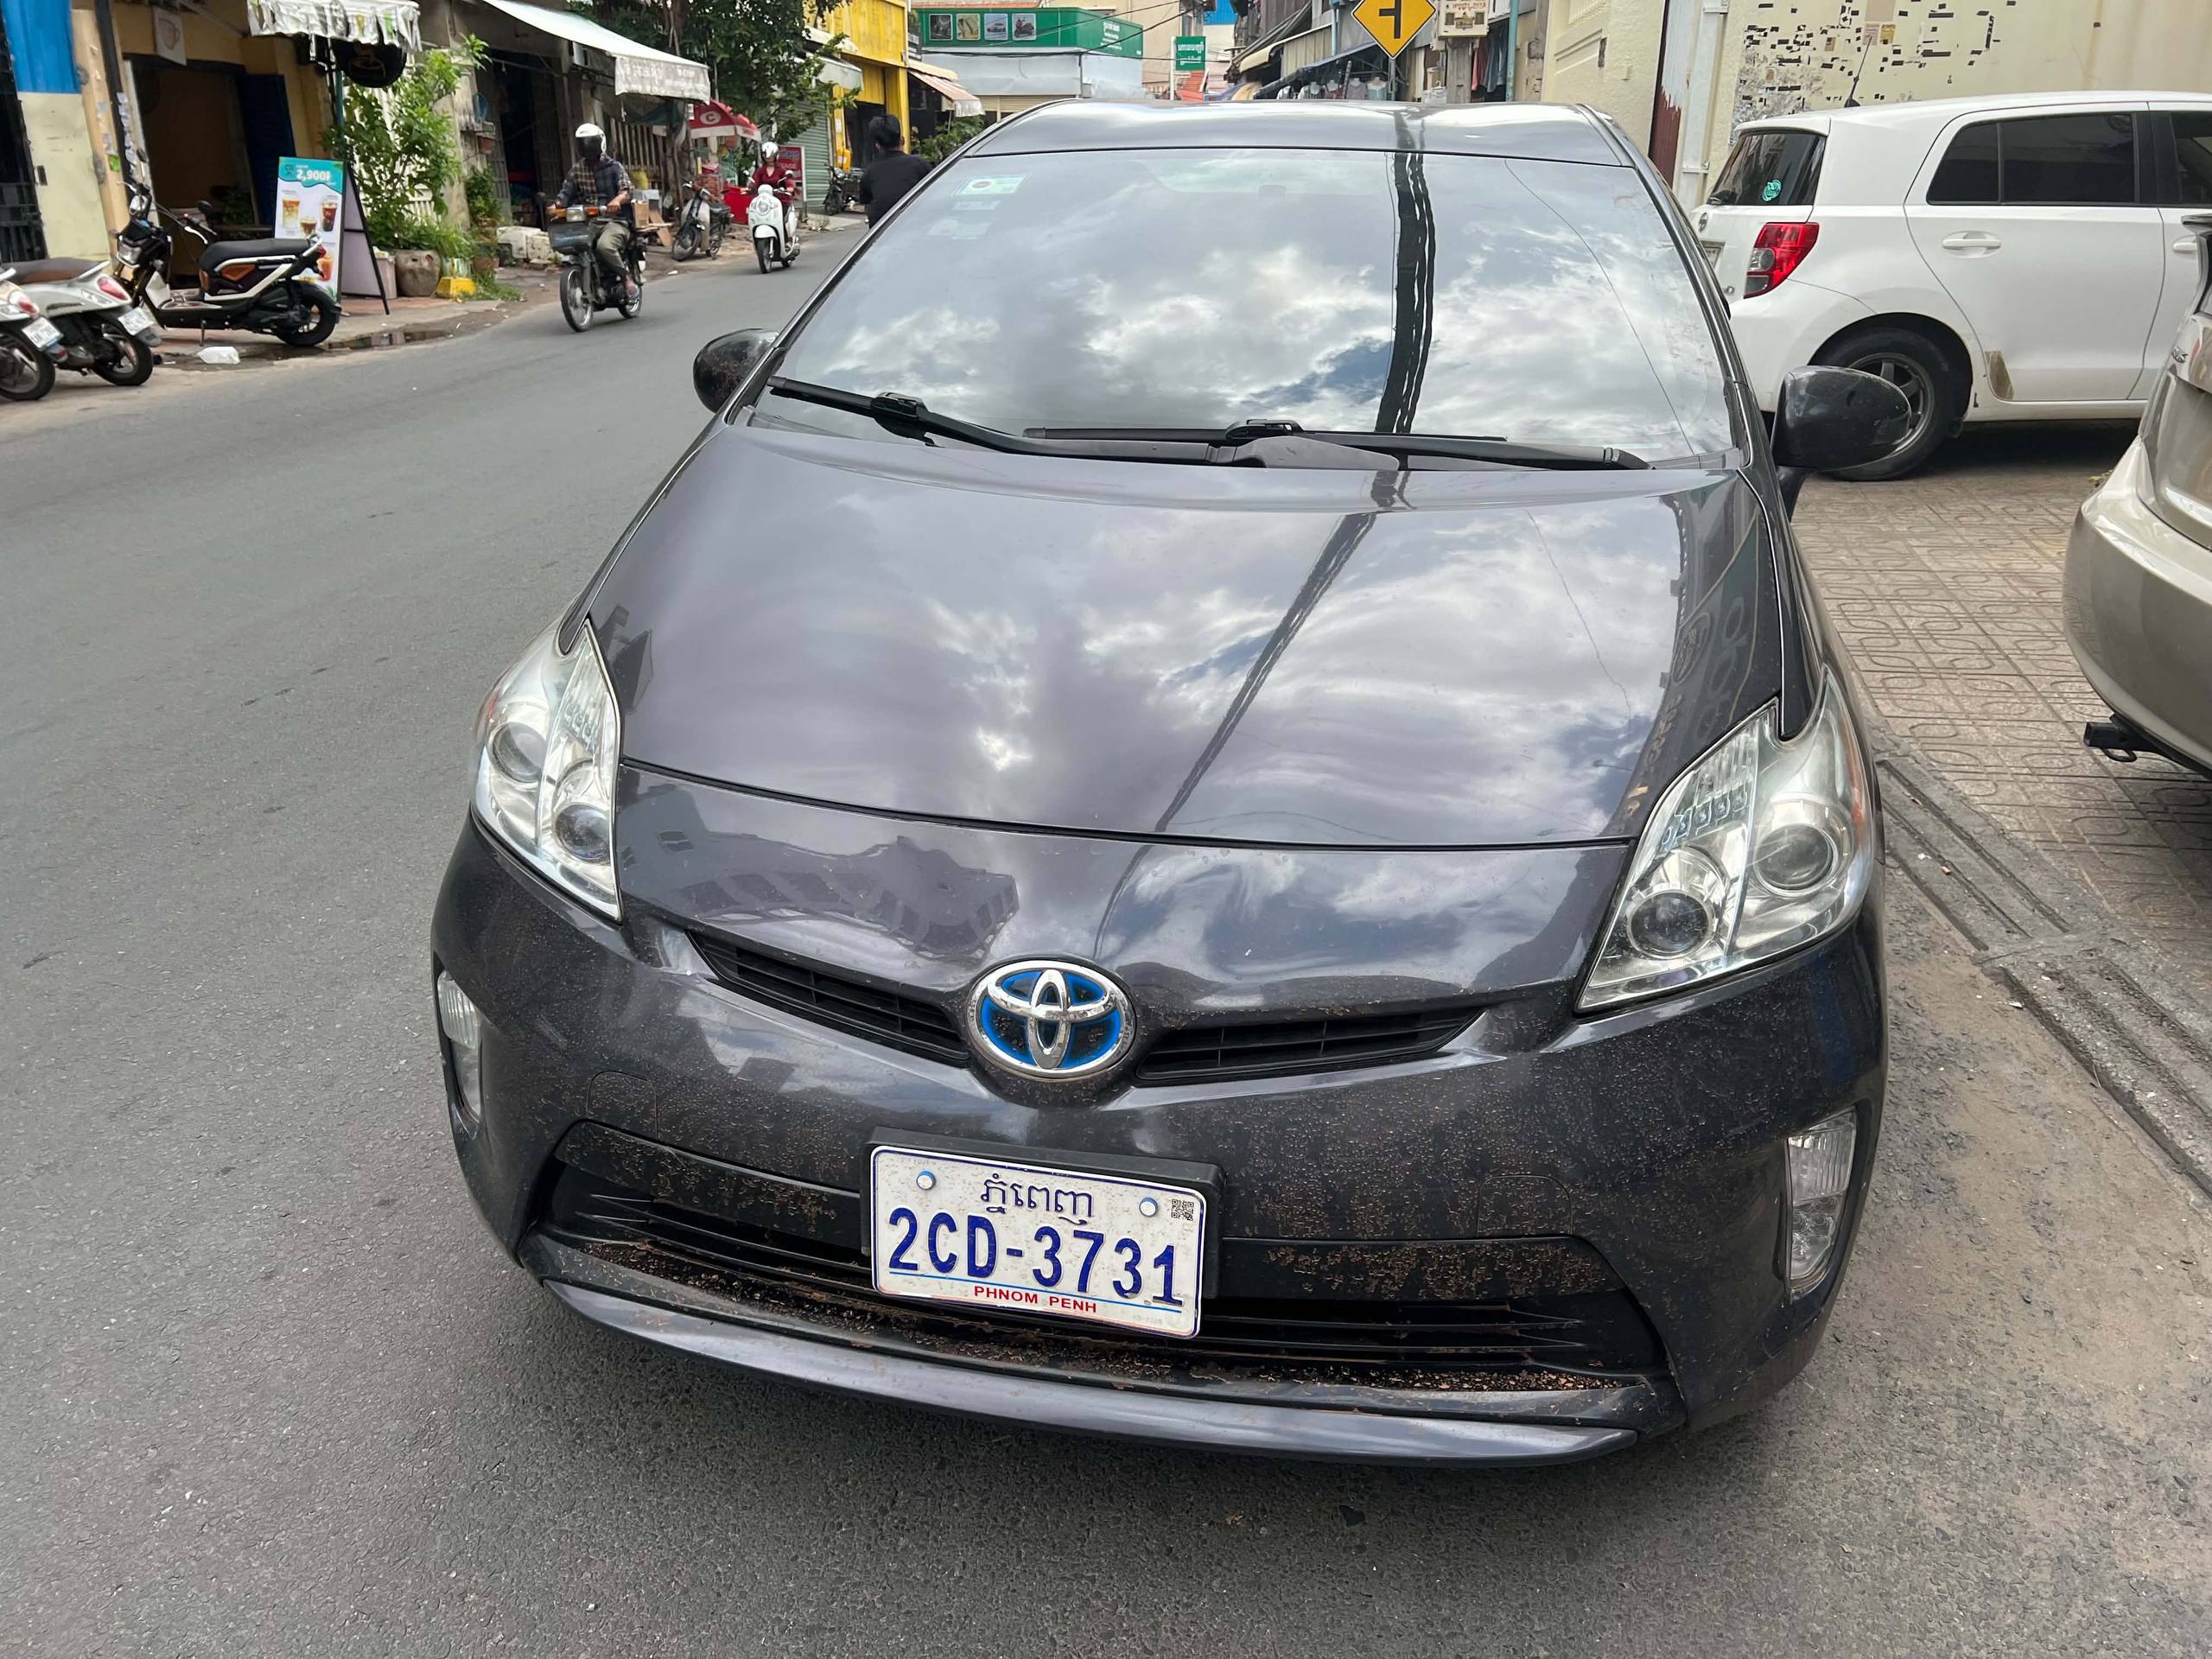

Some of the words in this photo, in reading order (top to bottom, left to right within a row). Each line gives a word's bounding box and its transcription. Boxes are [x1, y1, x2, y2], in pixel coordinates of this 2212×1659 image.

[980, 1173, 1093, 1225] ភ្នំពេញ
[888, 1207, 1184, 1306] 2CD-3731
[974, 1285, 1039, 1305] PHNOM
[1049, 1295, 1097, 1313] PENH
